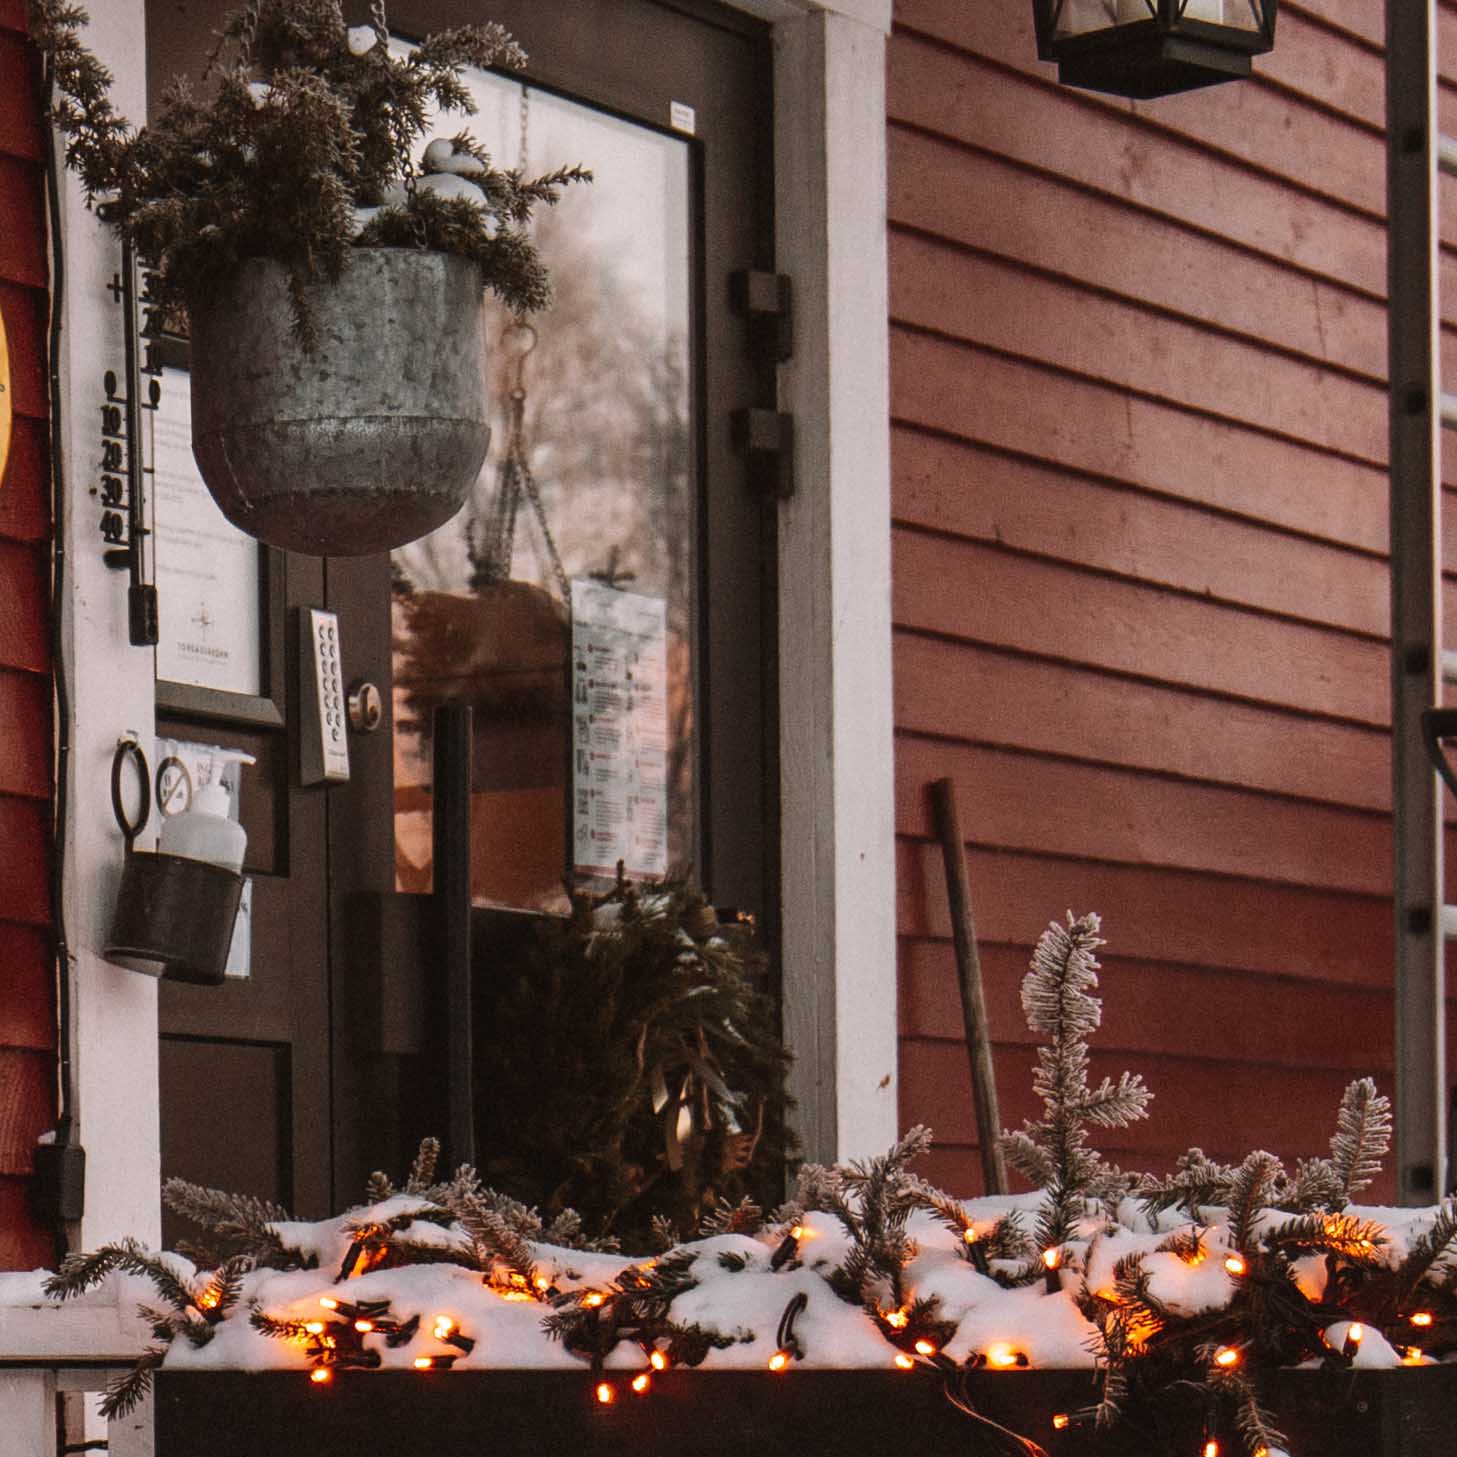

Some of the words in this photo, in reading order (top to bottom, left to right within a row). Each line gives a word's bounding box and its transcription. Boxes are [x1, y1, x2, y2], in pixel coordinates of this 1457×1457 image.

[100, 404, 122, 435] 10
[100, 439, 122, 470] 20
[100, 474, 123, 506] 30
[99, 510, 123, 541] 40
